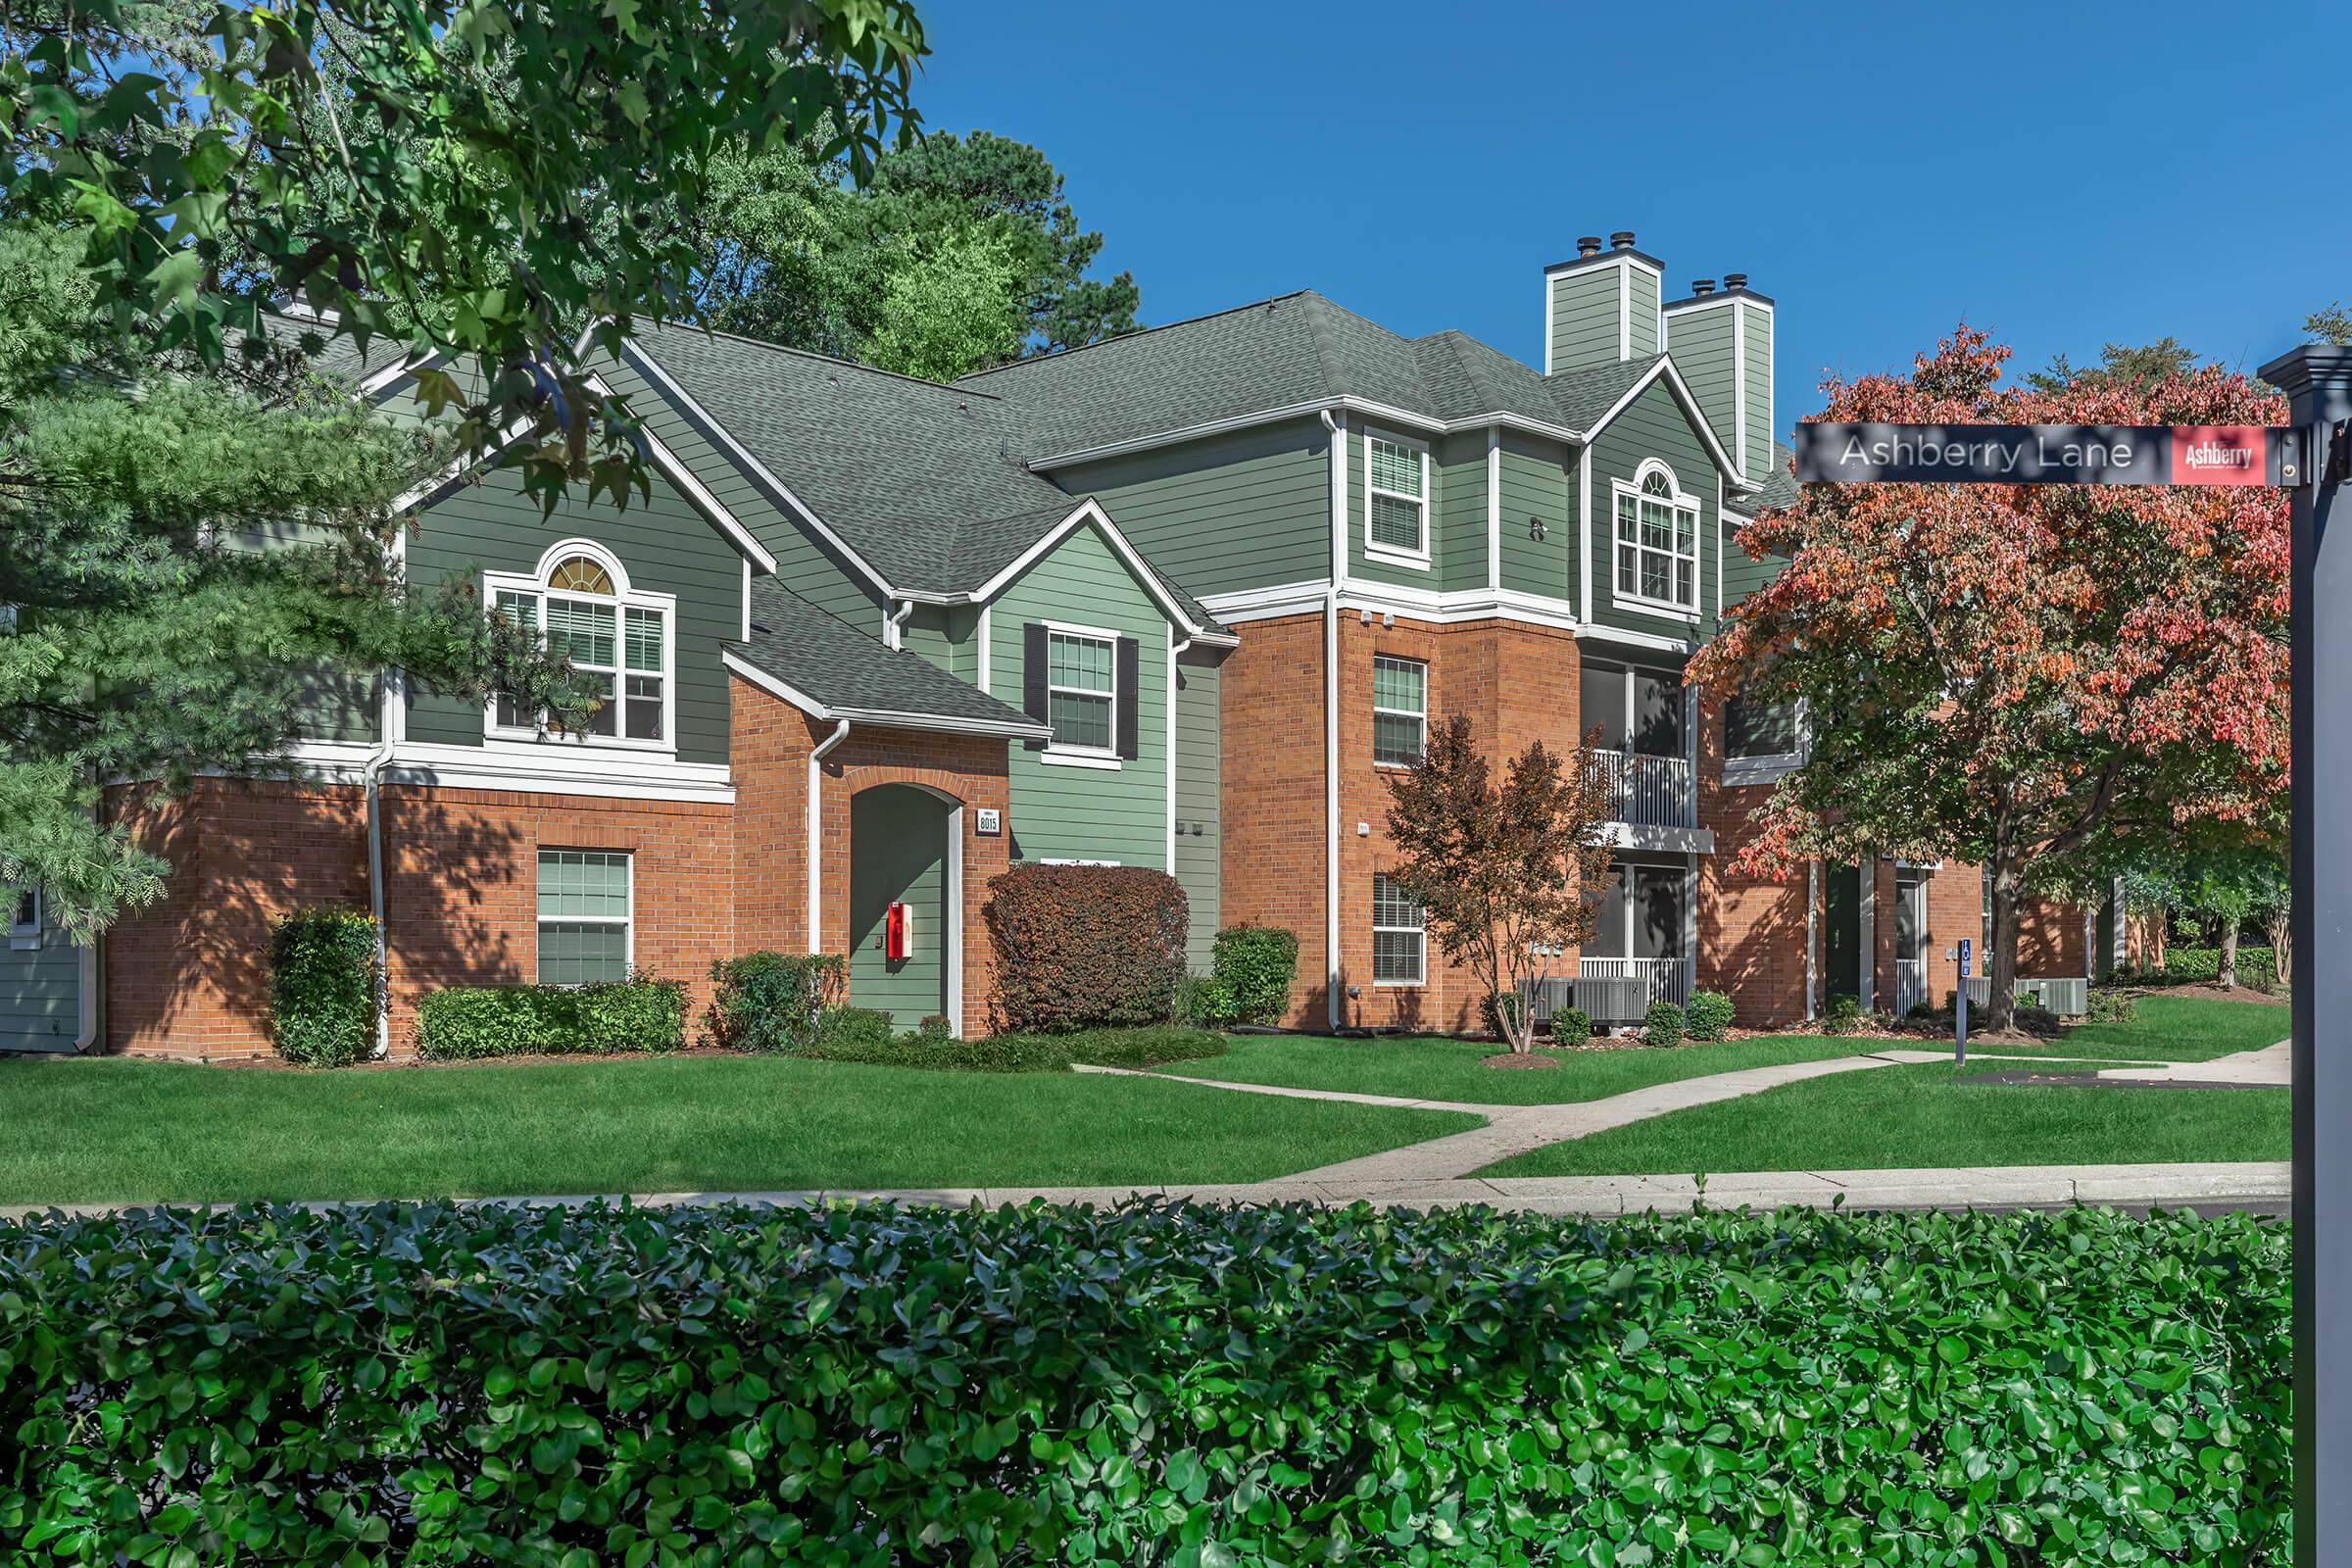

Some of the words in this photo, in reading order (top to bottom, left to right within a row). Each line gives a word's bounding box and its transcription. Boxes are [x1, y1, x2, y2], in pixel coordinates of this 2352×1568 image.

[1839, 434, 2023, 473] Ashberry
[2038, 436, 2132, 467] Lane
[2185, 441, 2252, 469] Ashberry
[980, 817, 997, 830] 8015
